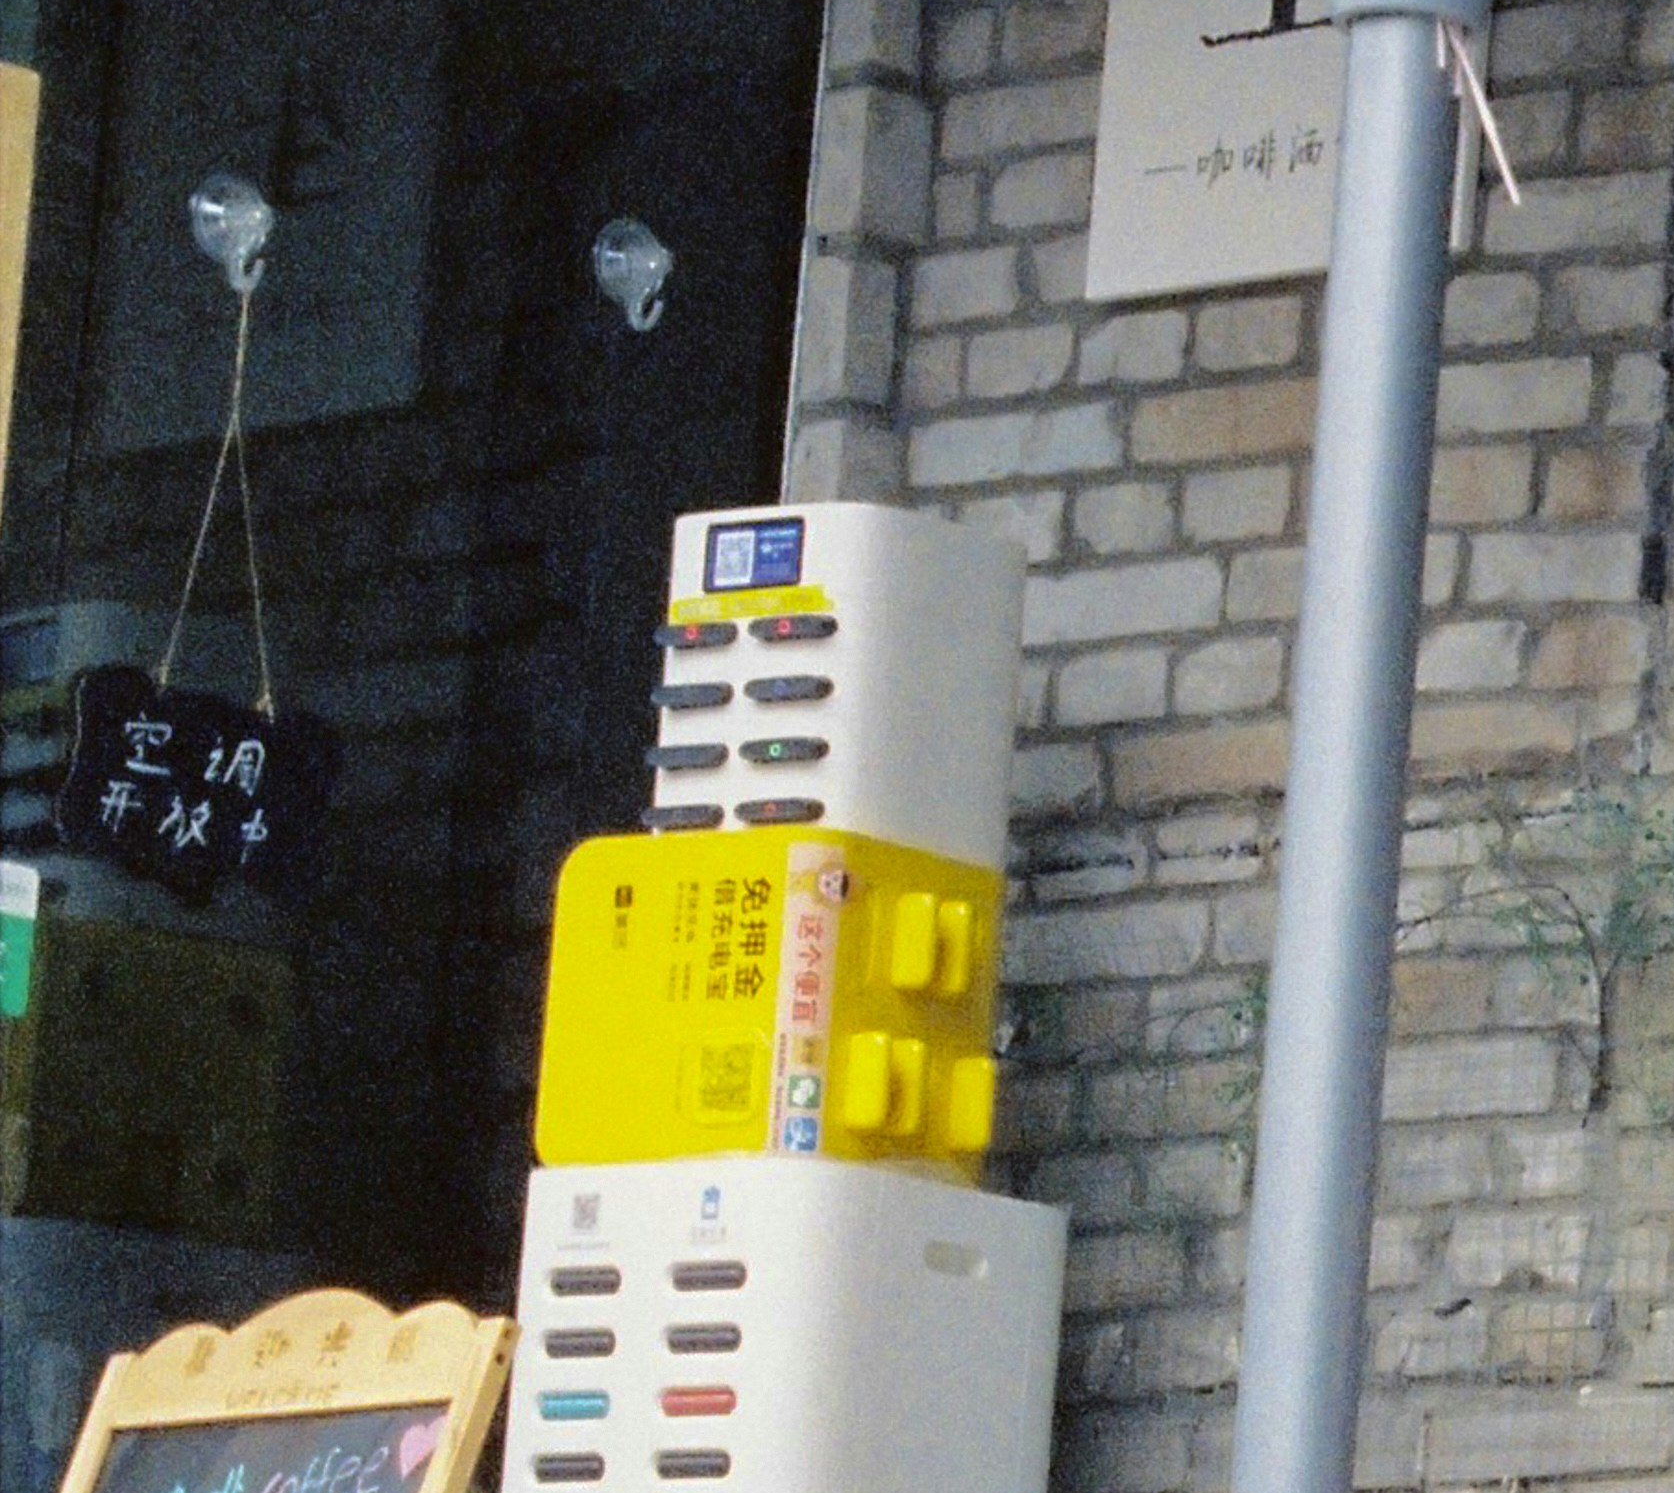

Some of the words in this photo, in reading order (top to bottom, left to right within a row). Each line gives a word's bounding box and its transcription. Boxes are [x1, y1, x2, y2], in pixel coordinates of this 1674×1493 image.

[124, 711, 266, 797] 空调
[100, 779, 269, 865] 开放中
[733, 876, 772, 1000] 免押金
